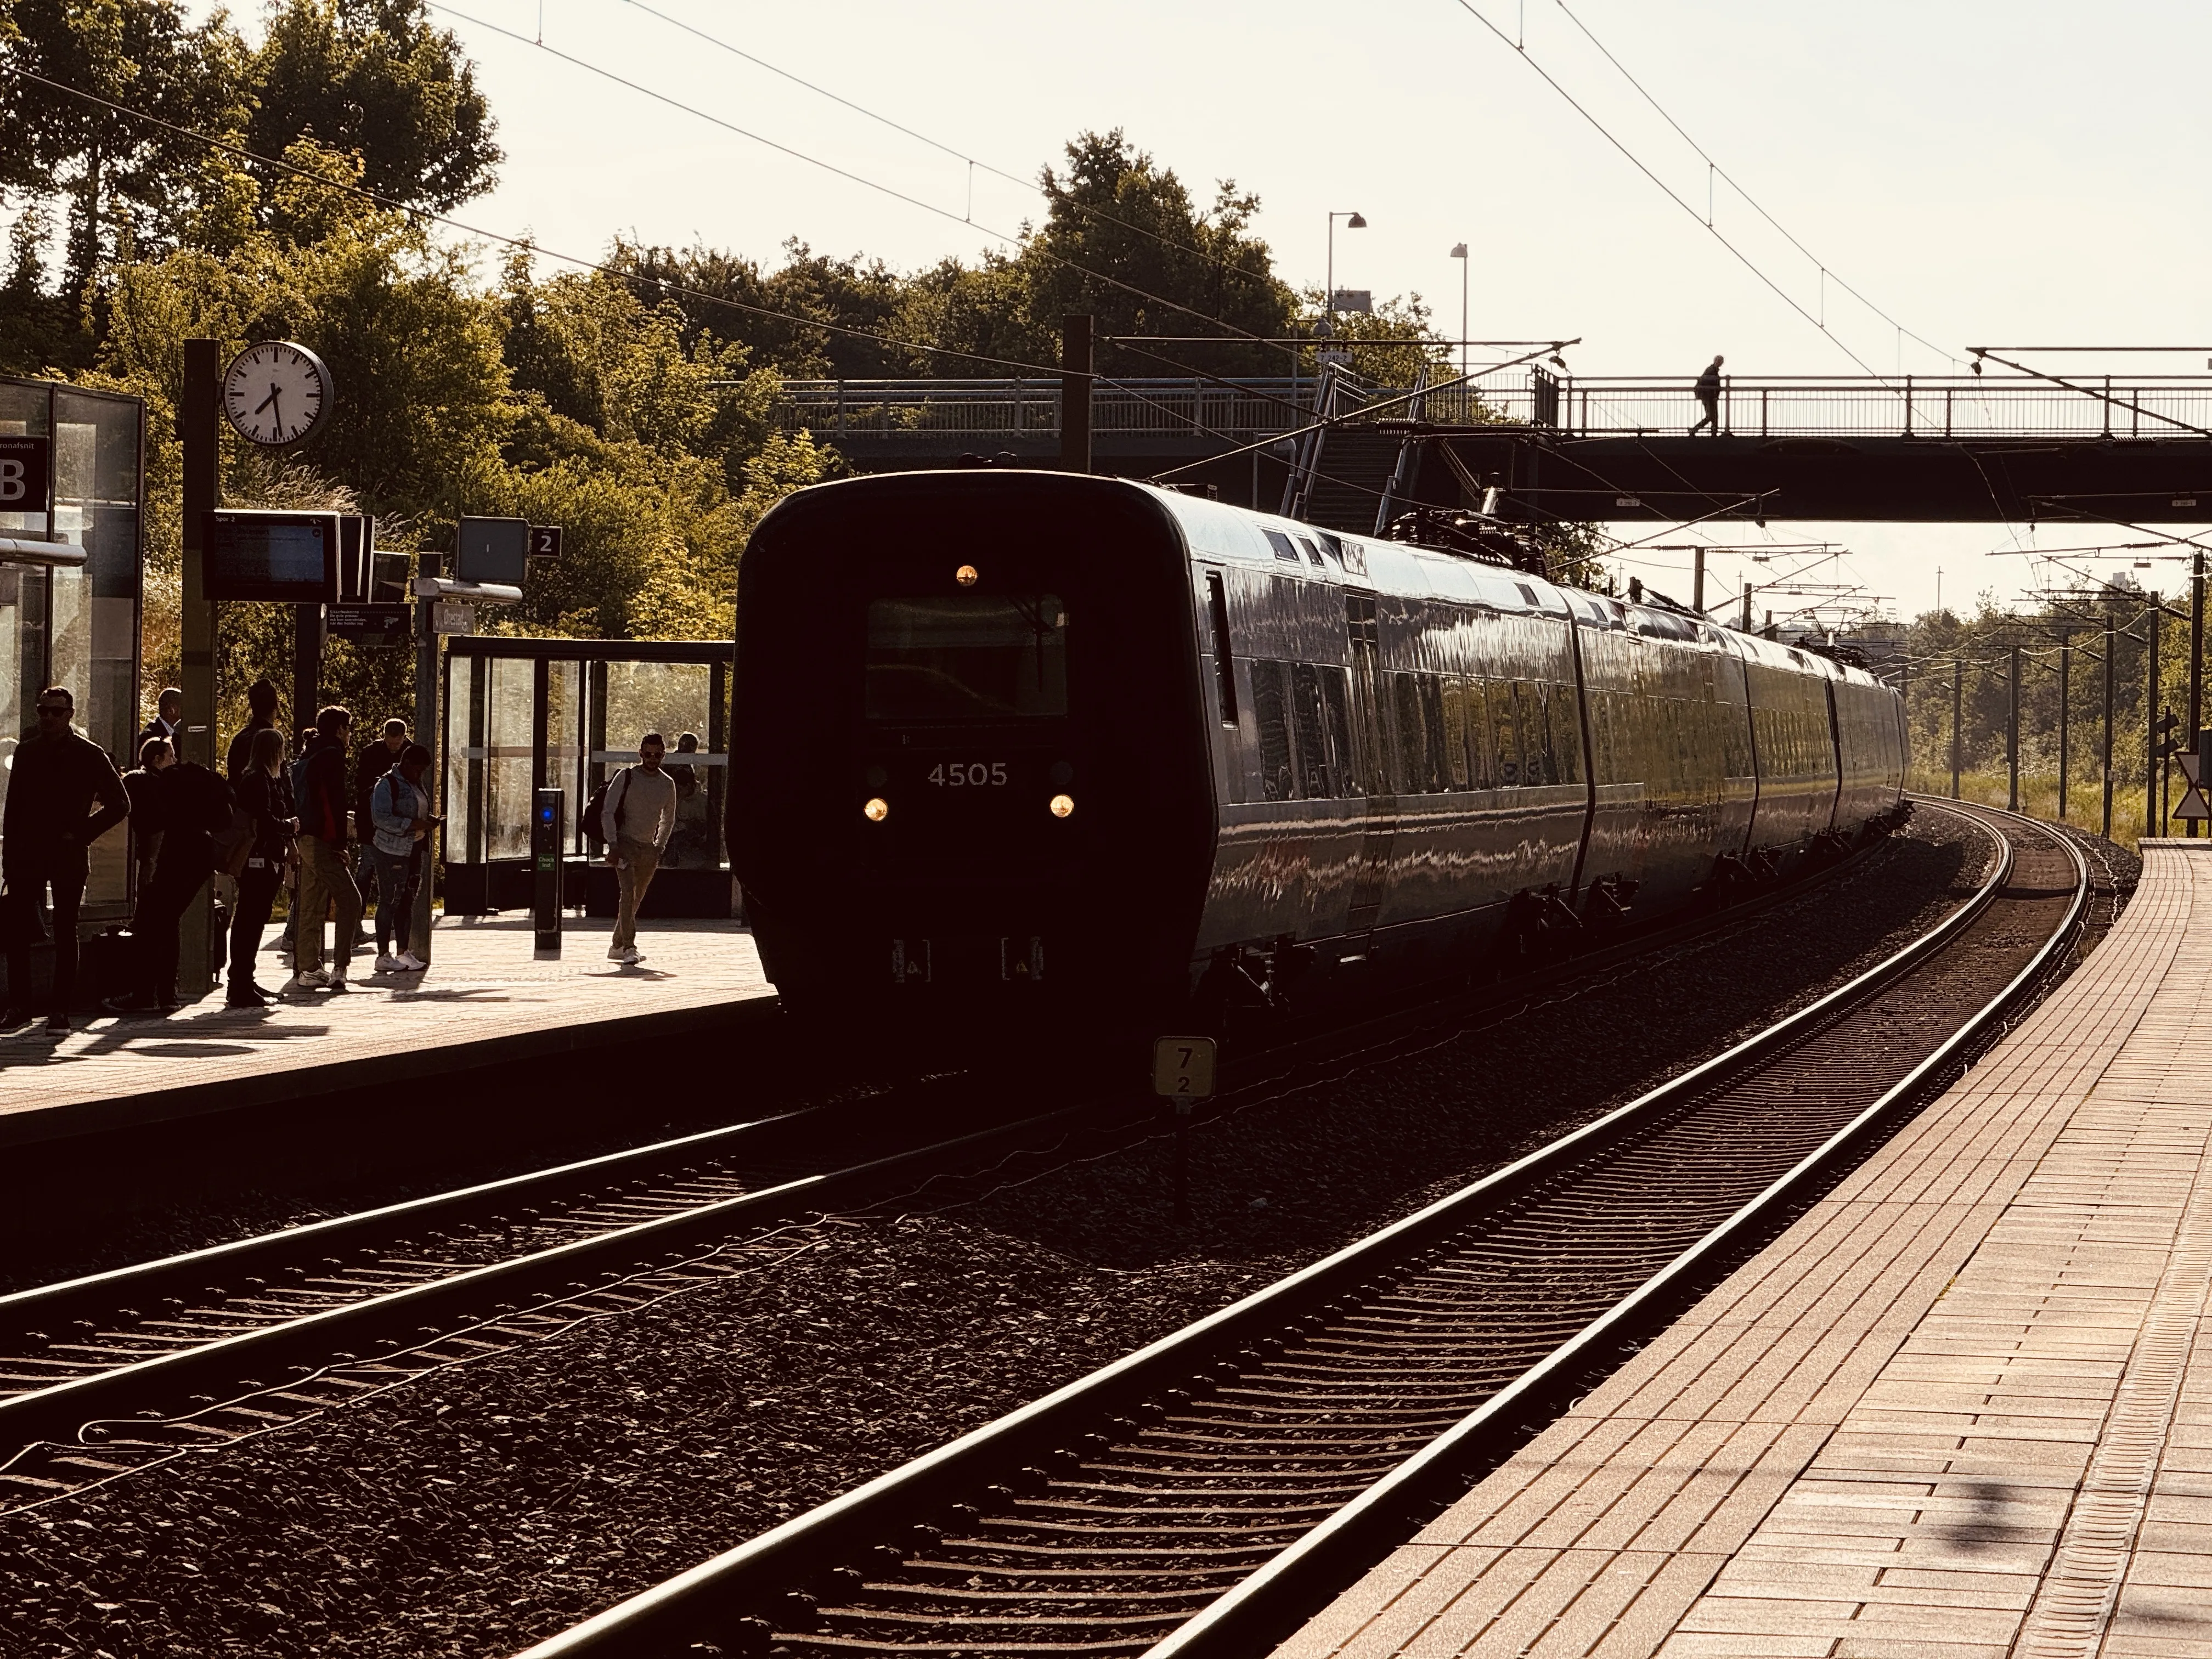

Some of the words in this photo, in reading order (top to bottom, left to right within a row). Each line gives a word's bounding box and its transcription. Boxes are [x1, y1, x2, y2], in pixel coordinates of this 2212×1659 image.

[0, 459, 26, 500] B
[540, 535, 551, 552] 2
[928, 763, 1007, 786] 4505
[1178, 1048, 1193, 1069] 7
[1178, 1076, 1190, 1092] 2
